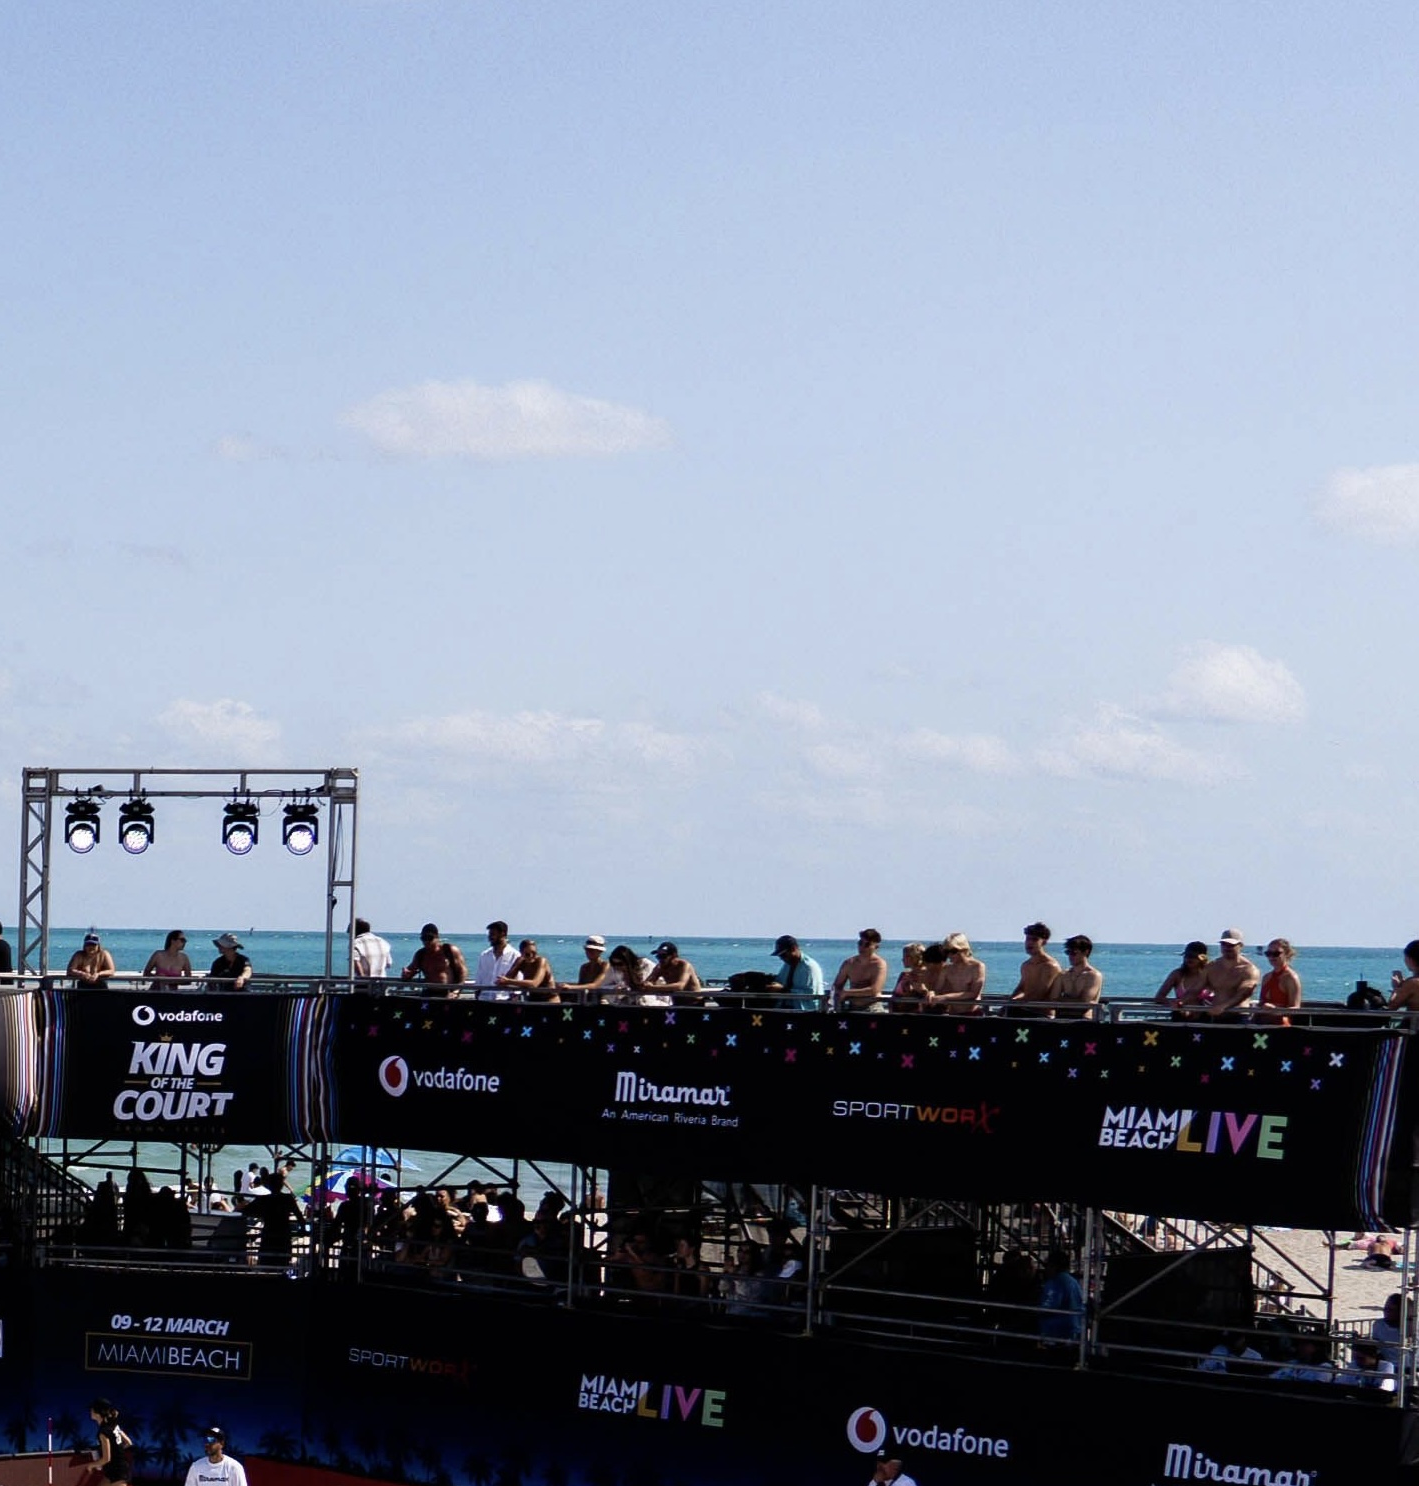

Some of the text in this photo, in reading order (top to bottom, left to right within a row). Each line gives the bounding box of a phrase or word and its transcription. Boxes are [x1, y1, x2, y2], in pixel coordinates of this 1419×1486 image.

[158, 1009, 223, 1023] vodafone
[128, 1041, 226, 1077] KING
[150, 1077, 194, 1090] OF THE
[412, 1067, 500, 1094] vodafone
[614, 1071, 730, 1106] Miramar
[113, 1090, 234, 1121] COURT
[601, 1109, 739, 1128] An American Riveria Brand
[1102, 1105, 1195, 1132] MIAMI
[1099, 1127, 1174, 1149] BEACH
[1176, 1111, 1288, 1160] LIVE
[109, 1314, 132, 1331] 09
[144, 1316, 162, 1332] 12
[164, 1316, 230, 1336] MARCH
[97, 1342, 241, 1370] MIAMIBEACH
[579, 1373, 651, 1398] MIAMI
[577, 1392, 637, 1414] BEACH
[637, 1380, 727, 1428] LIVE
[892, 1423, 1009, 1458] vodafone
